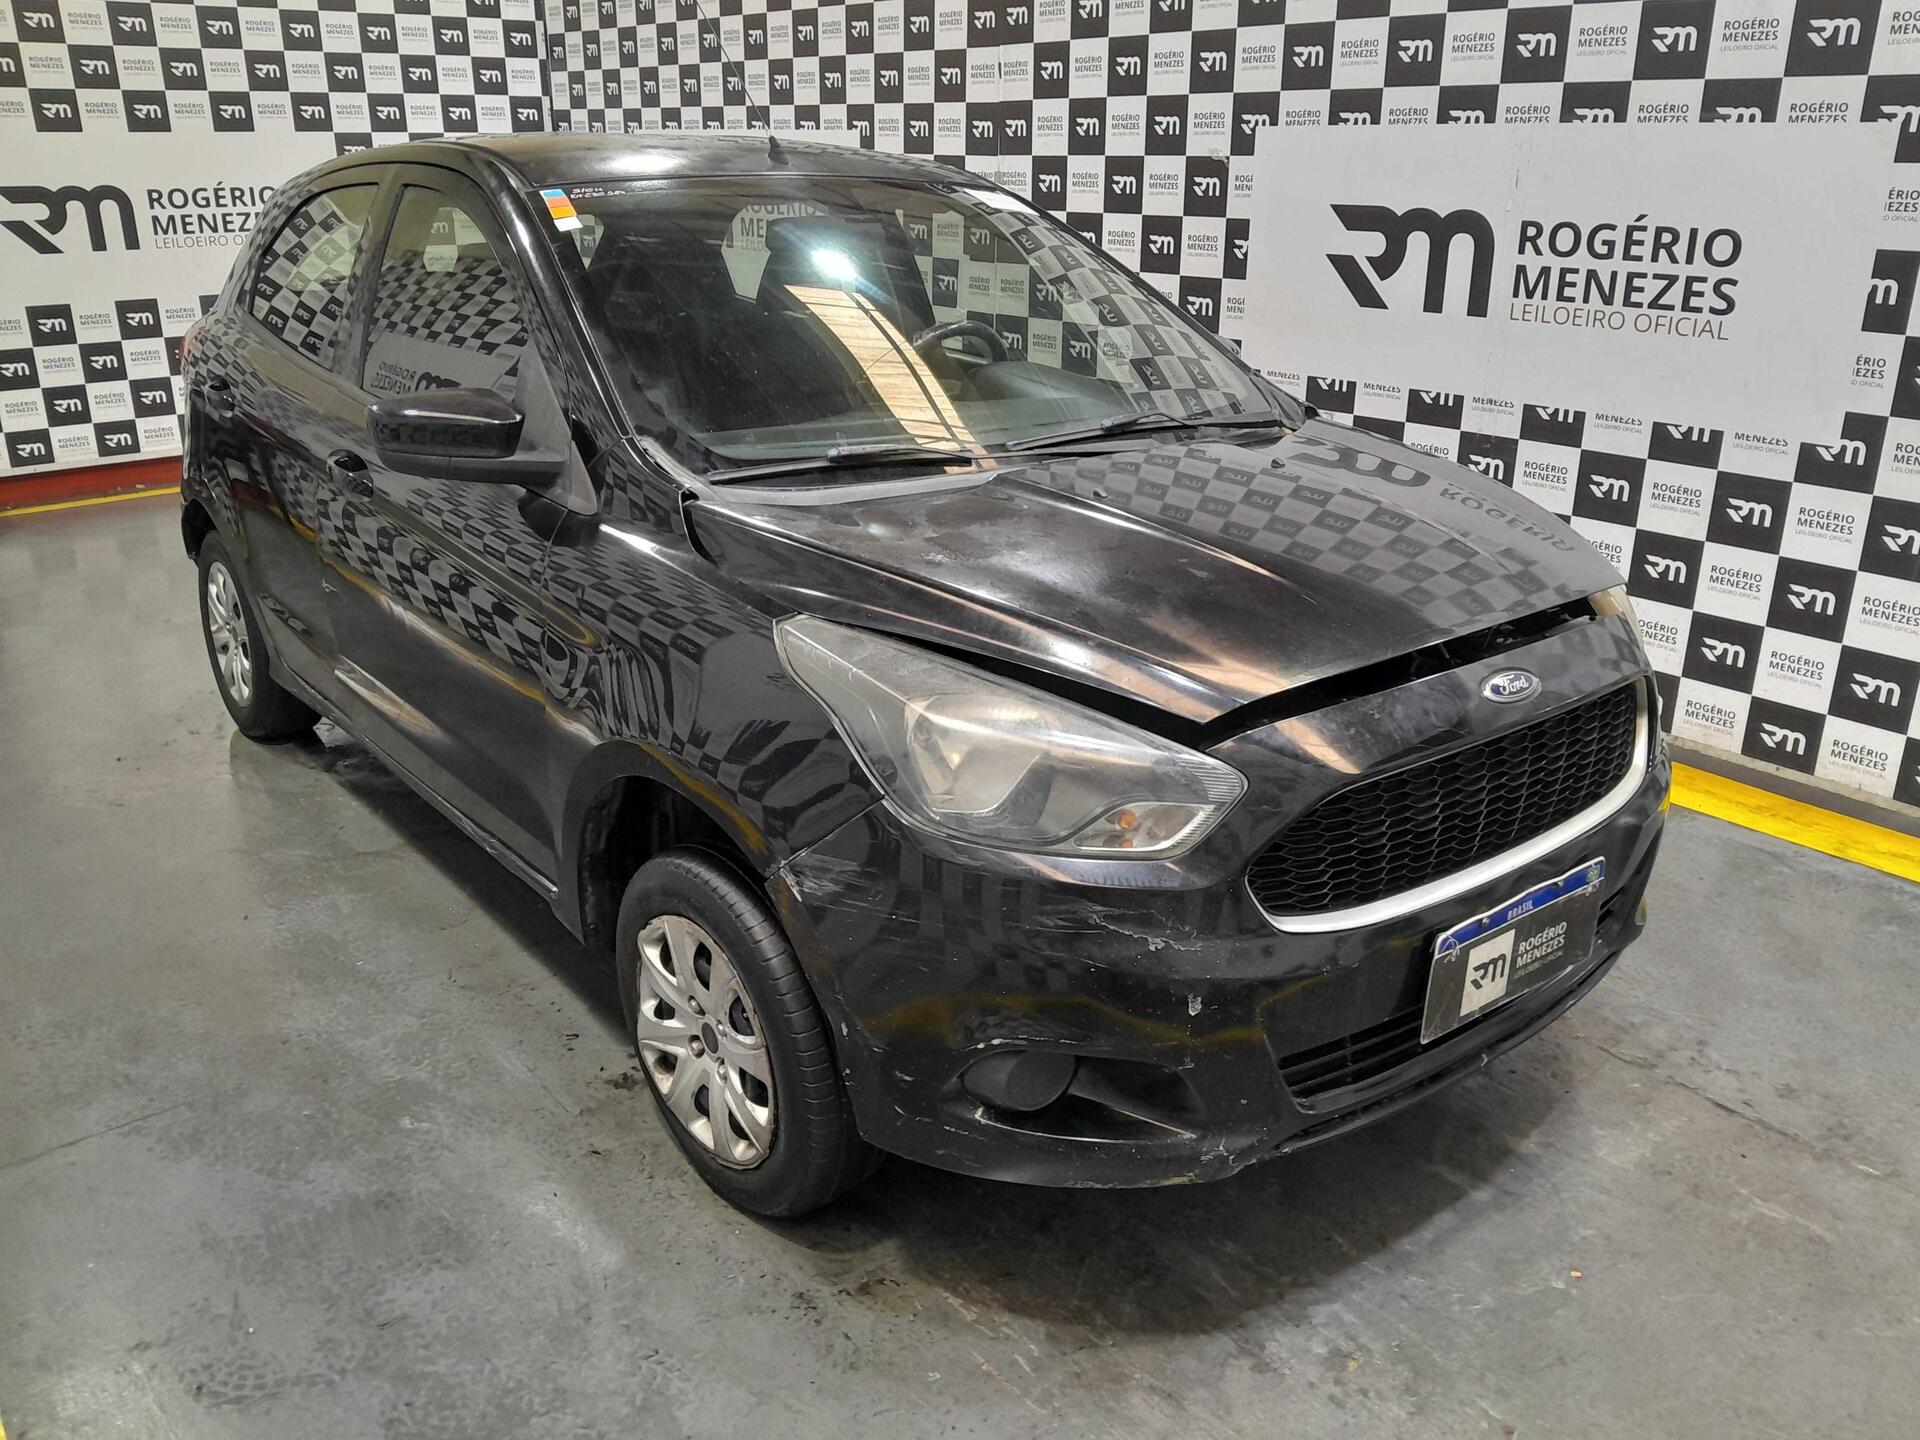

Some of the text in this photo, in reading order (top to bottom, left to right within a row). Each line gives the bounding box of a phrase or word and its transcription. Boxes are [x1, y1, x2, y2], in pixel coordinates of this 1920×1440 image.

[160, 16, 190, 24] ROGÉRIO
[939, 11, 962, 19] ROGÉRIO
[68, 18, 102, 26] MENEZES
[939, 18, 962, 26] MENEZES
[1723, 17, 1780, 31] ROGÉRIO
[1579, 24, 1628, 37] ROGÉRIO
[1722, 30, 1778, 42] MENEZES
[1341, 39, 1379, 49] ROGÉRIO
[1452, 32, 1495, 44] ROGÉRIO
[1578, 36, 1626, 48] MENEZES
[1242, 45, 1276, 55] ROGÉRIO
[1341, 48, 1378, 58] MENEZES
[1452, 43, 1495, 54] MENEZES
[1075, 55, 1102, 64] ROGÉRIO
[1154, 51, 1184, 60] ROGÉRIO
[1242, 54, 1276, 63] MENEZES
[1075, 64, 1102, 73] MENEZES
[1154, 59, 1184, 69] MENEZES
[1389, 107, 1428, 117] ROGÉRIO
[1505, 104, 1550, 116] ROGÉRIO
[1638, 102, 1689, 114] ROGÉRIO
[1790, 100, 1848, 113] ROGÉRIO
[1112, 114, 1140, 122] ROGÉRIO
[1194, 112, 1225, 120] ROGÉRIO
[1286, 108, 1321, 119] ROGÉRIO
[1112, 121, 1140, 130] MENEZES
[1194, 120, 1225, 129] MENEZES
[1072, 171, 1099, 180] ROGÉRIO
[1149, 173, 1178, 181] ROGÉRIO
[1072, 180, 1099, 188] MENEZES
[1149, 181, 1178, 190] MENEZES
[1108, 230, 1135, 238] ROGÉRIO
[1188, 234, 1218, 243] ROGÉRIO
[154, 235, 228, 249] LEILOEIRO
[1107, 238, 1135, 246] MENEZES
[1518, 214, 1742, 268] ROGÉRIO
[1187, 243, 1218, 252] MENEZES
[1512, 265, 1738, 317] MENEZES
[79, 313, 110, 321] ROGÉRIO
[1510, 303, 1729, 341] LEILOEIRO OFICIAL
[42, 356, 74, 364] ROGÉRIO
[144, 426, 173, 434] ROGÉRIO
[1524, 461, 1568, 475] ROGÉRIO
[1523, 470, 1567, 484] MENEZES
[1653, 482, 1702, 498] ROGÉRIO
[1651, 491, 1701, 509] MENEZES
[1799, 507, 1855, 525] ROGÉRIO
[1797, 516, 1853, 536] MENEZES
[1711, 565, 1762, 583] ROGÉRIO
[1709, 574, 1761, 593] MENEZES
[1863, 596, 1920, 615] ROGÉRIO
[1861, 606, 1919, 627] MENEZES
[1771, 650, 1824, 670] ROGÉRIO
[1769, 660, 1823, 681] MENEZES
[1497, 674, 1529, 695] Ford
[1686, 700, 1736, 720] ROGÉRIO
[1685, 708, 1734, 729] MENEZES
[1832, 739, 1888, 762] ROGÉRIO
[1830, 749, 1886, 772] MENEZES
[1507, 900, 1533, 920] BRASIL
[1519, 921, 1567, 955] ROGÉRIO
[1516, 934, 1565, 968] MENEZES
